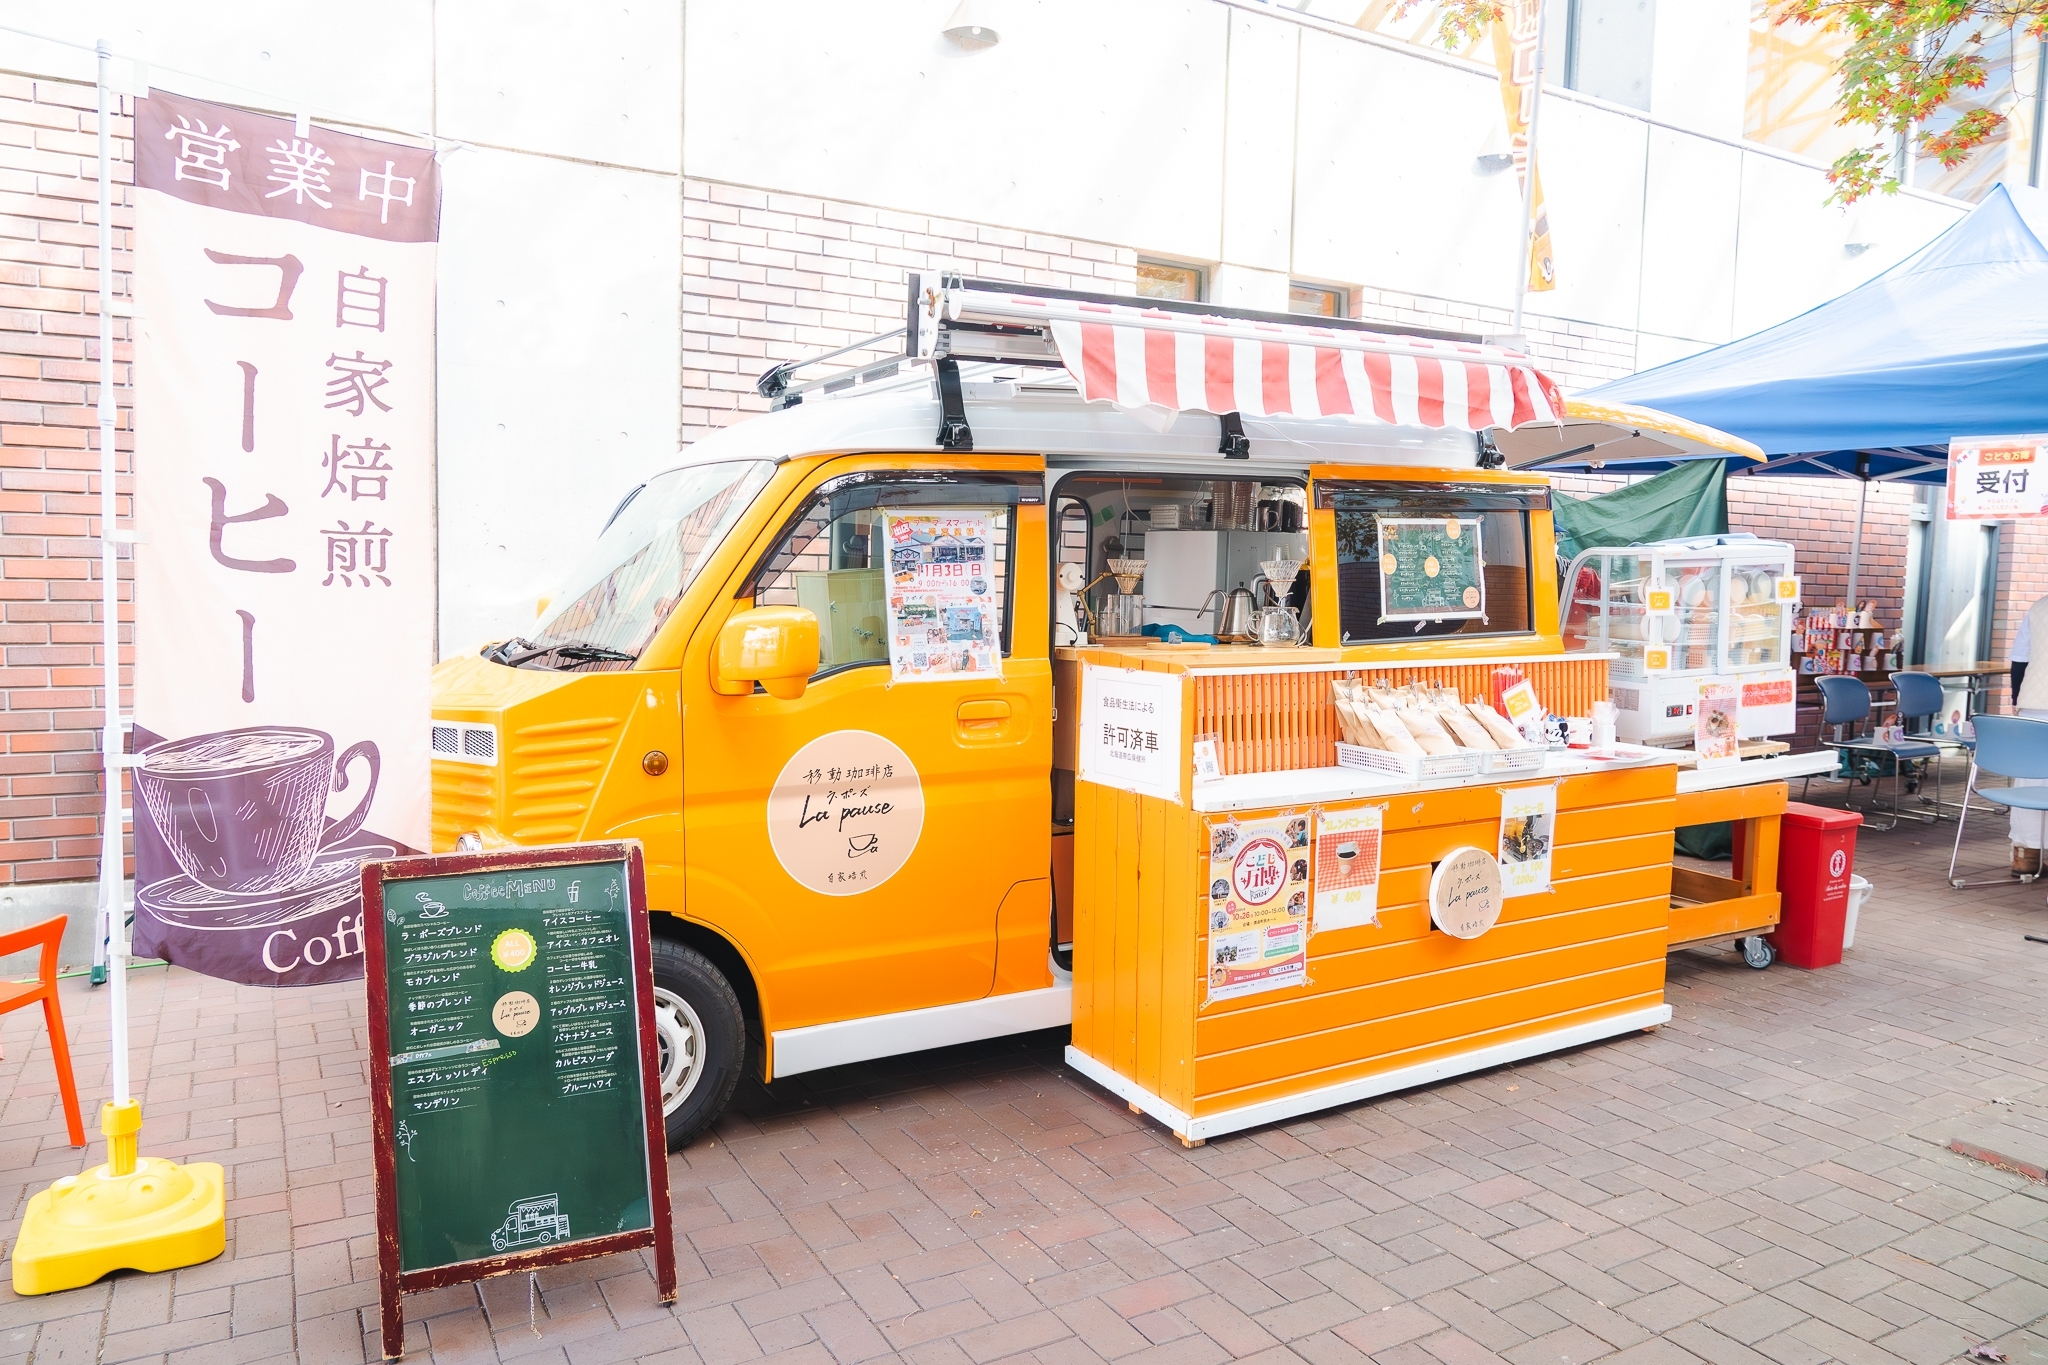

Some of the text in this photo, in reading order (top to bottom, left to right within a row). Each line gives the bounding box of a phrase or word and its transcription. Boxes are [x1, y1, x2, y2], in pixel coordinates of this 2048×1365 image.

[165, 114, 417, 226] 営業中
[321, 265, 393, 588] 自家焙煎
[203, 248, 304, 704] コーヒー
[1976, 469, 2029, 494] 受付
[893, 524, 910, 534] 出店
[1103, 696, 1155, 714] 食品衛生法による
[1103, 723, 1159, 753] 許可済車
[803, 764, 894, 785] 移動珈琲店
[799, 795, 894, 832] La pause
[1324, 816, 1380, 832] ブレンドコーヒー
[828, 869, 868, 883] 自家焙煎
[463, 883, 506, 901] Coffee
[1448, 884, 1490, 907] La pause
[542, 914, 601, 927] アイスコーヒー
[504, 940, 521, 949] ALL
[546, 934, 620, 949] アイス・カフェオレ
[404, 947, 478, 964] ブラジルブレンド
[547, 960, 598, 973] コーヒー牛乳
[405, 972, 461, 986] モカブレンド
[407, 996, 472, 1013] 季節のブレンド
[409, 1021, 464, 1037] オーガニック
[554, 1027, 614, 1043] バナナジュース
[482, 1050, 517, 1067] Espresso
[555, 1050, 615, 1068] カルピスソーダ
[407, 1066, 488, 1085] エスプレッソレディ
[561, 1078, 612, 1094] ブルーハワイ
[414, 1097, 460, 1110] マンデリン
